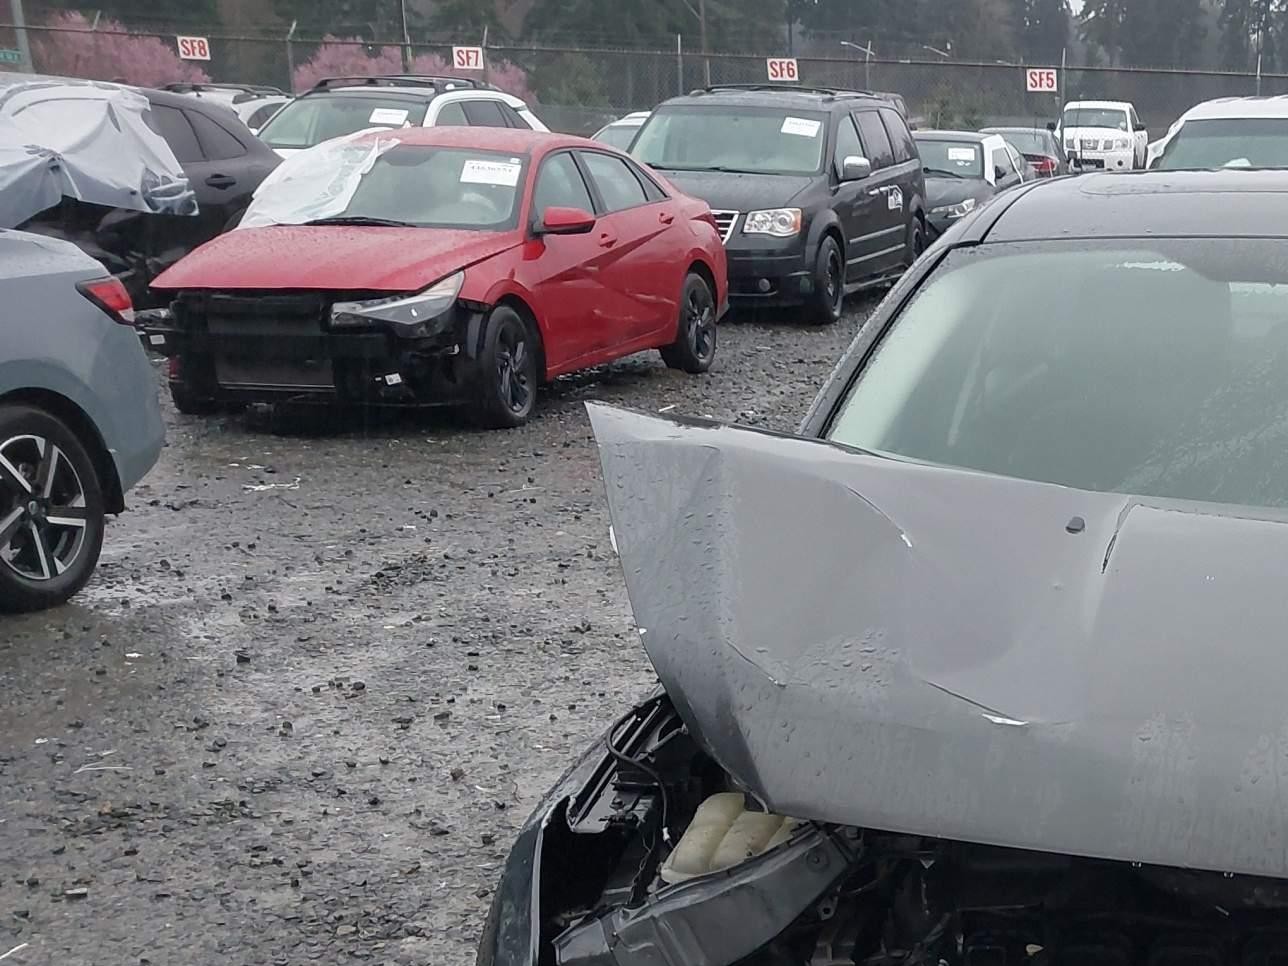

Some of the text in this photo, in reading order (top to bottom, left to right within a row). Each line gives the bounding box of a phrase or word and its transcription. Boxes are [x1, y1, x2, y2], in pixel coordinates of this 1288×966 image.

[180, 39, 208, 57] SF8
[456, 49, 480, 67] SF7
[770, 61, 796, 78] SF6
[1029, 71, 1055, 89] SF5
